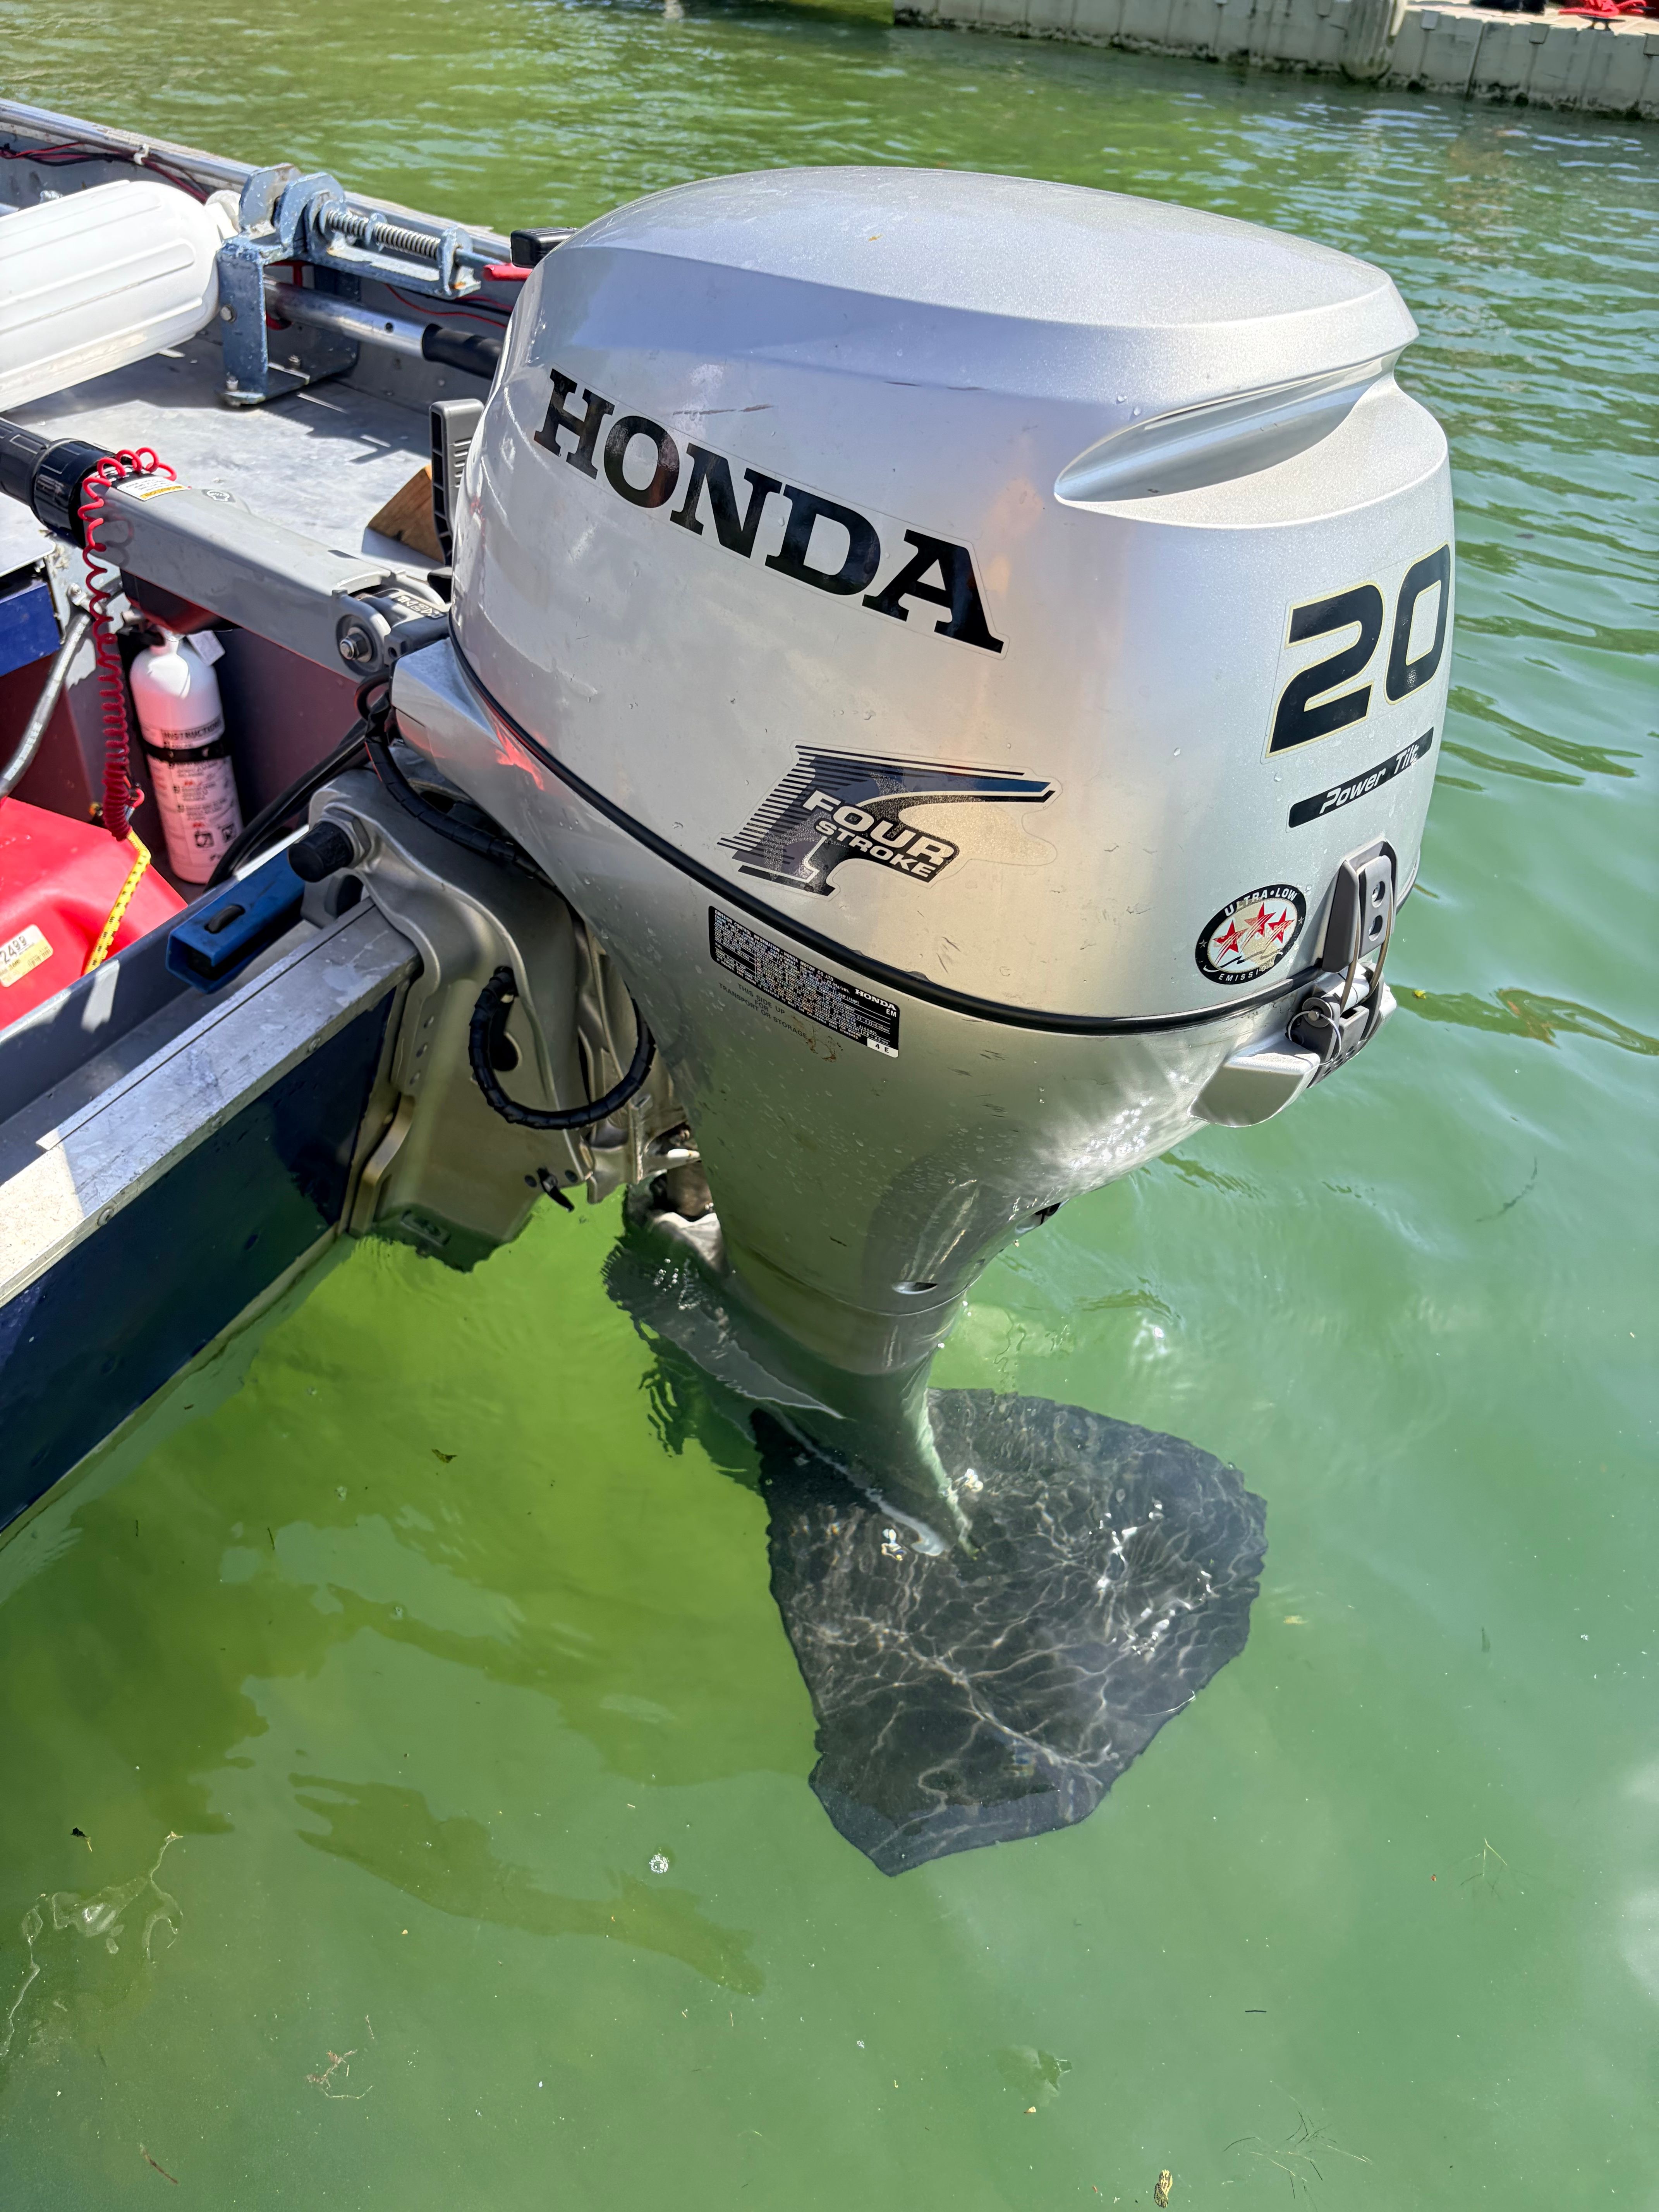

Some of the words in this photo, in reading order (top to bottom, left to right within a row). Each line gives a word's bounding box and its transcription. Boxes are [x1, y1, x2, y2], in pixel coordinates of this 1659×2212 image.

[534, 368, 1004, 653] HONDA
[1267, 542, 1451, 757] 20
[1319, 768, 1386, 814] Power
[1394, 744, 1419, 775] Tilt
[802, 790, 954, 866] FOUR
[816, 820, 936, 878] STROKE
[715, 909, 732, 924] EMISSION
[734, 922, 751, 936] CONTROL
[754, 934, 779, 953] INFORMATION
[784, 951, 798, 963] HONDA
[800, 960, 814, 972] MOTOR
[1219, 956, 1274, 982] EMISSION
[719, 982, 759, 1012] TRANSPORT
[761, 1010, 771, 1019] OR
[773, 1017, 807, 1039] STORAGE
[738, 983, 754, 997] THIS
[756, 995, 772, 1008] SIDE
[776, 1006, 785, 1014] UP
[755, 1000, 769, 1012] FOR
[855, 988, 897, 1011] HONDA
[886, 1009, 896, 1018] EM
